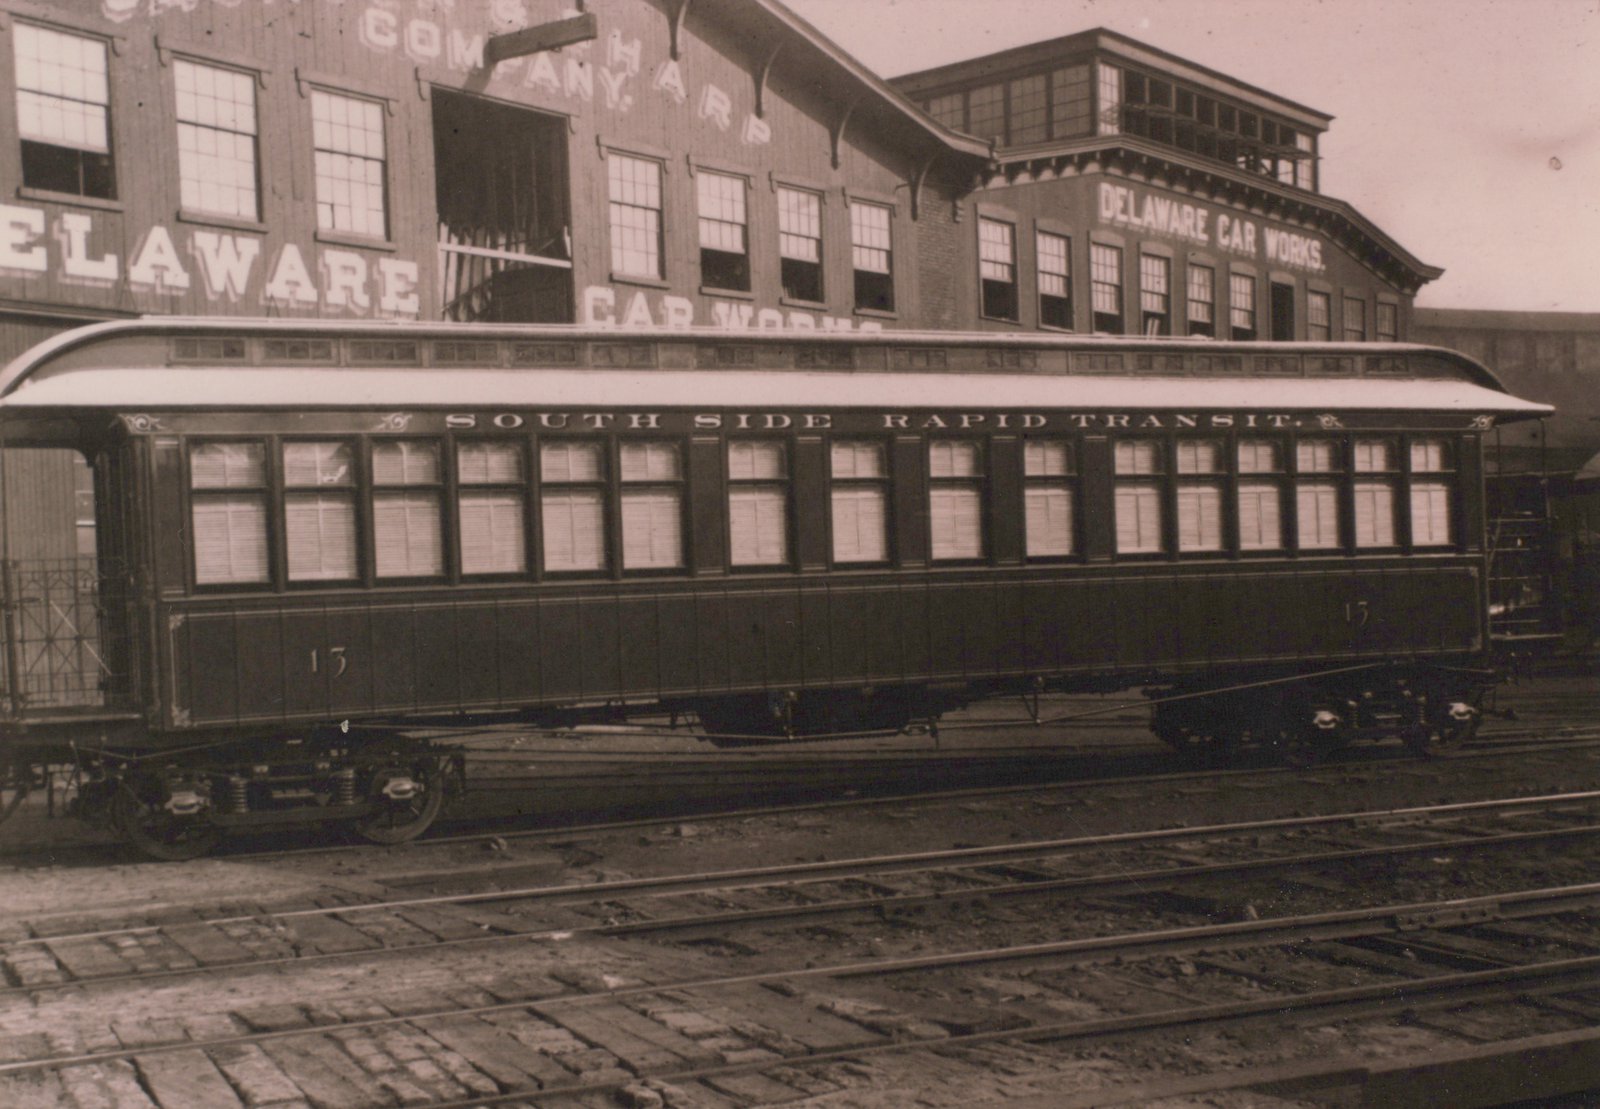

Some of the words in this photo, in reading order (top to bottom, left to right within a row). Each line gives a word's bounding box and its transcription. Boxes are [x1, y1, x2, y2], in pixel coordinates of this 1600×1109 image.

[1099, 182, 1208, 241] DELAWARE
[1217, 214, 1256, 253] CAR
[1264, 227, 1326, 270] WORKS.
[446, 412, 662, 430] SOUTH
[694, 413, 832, 430] SIDE
[883, 413, 1049, 429] RAPID
[1071, 413, 1303, 429] TRANSIT.
